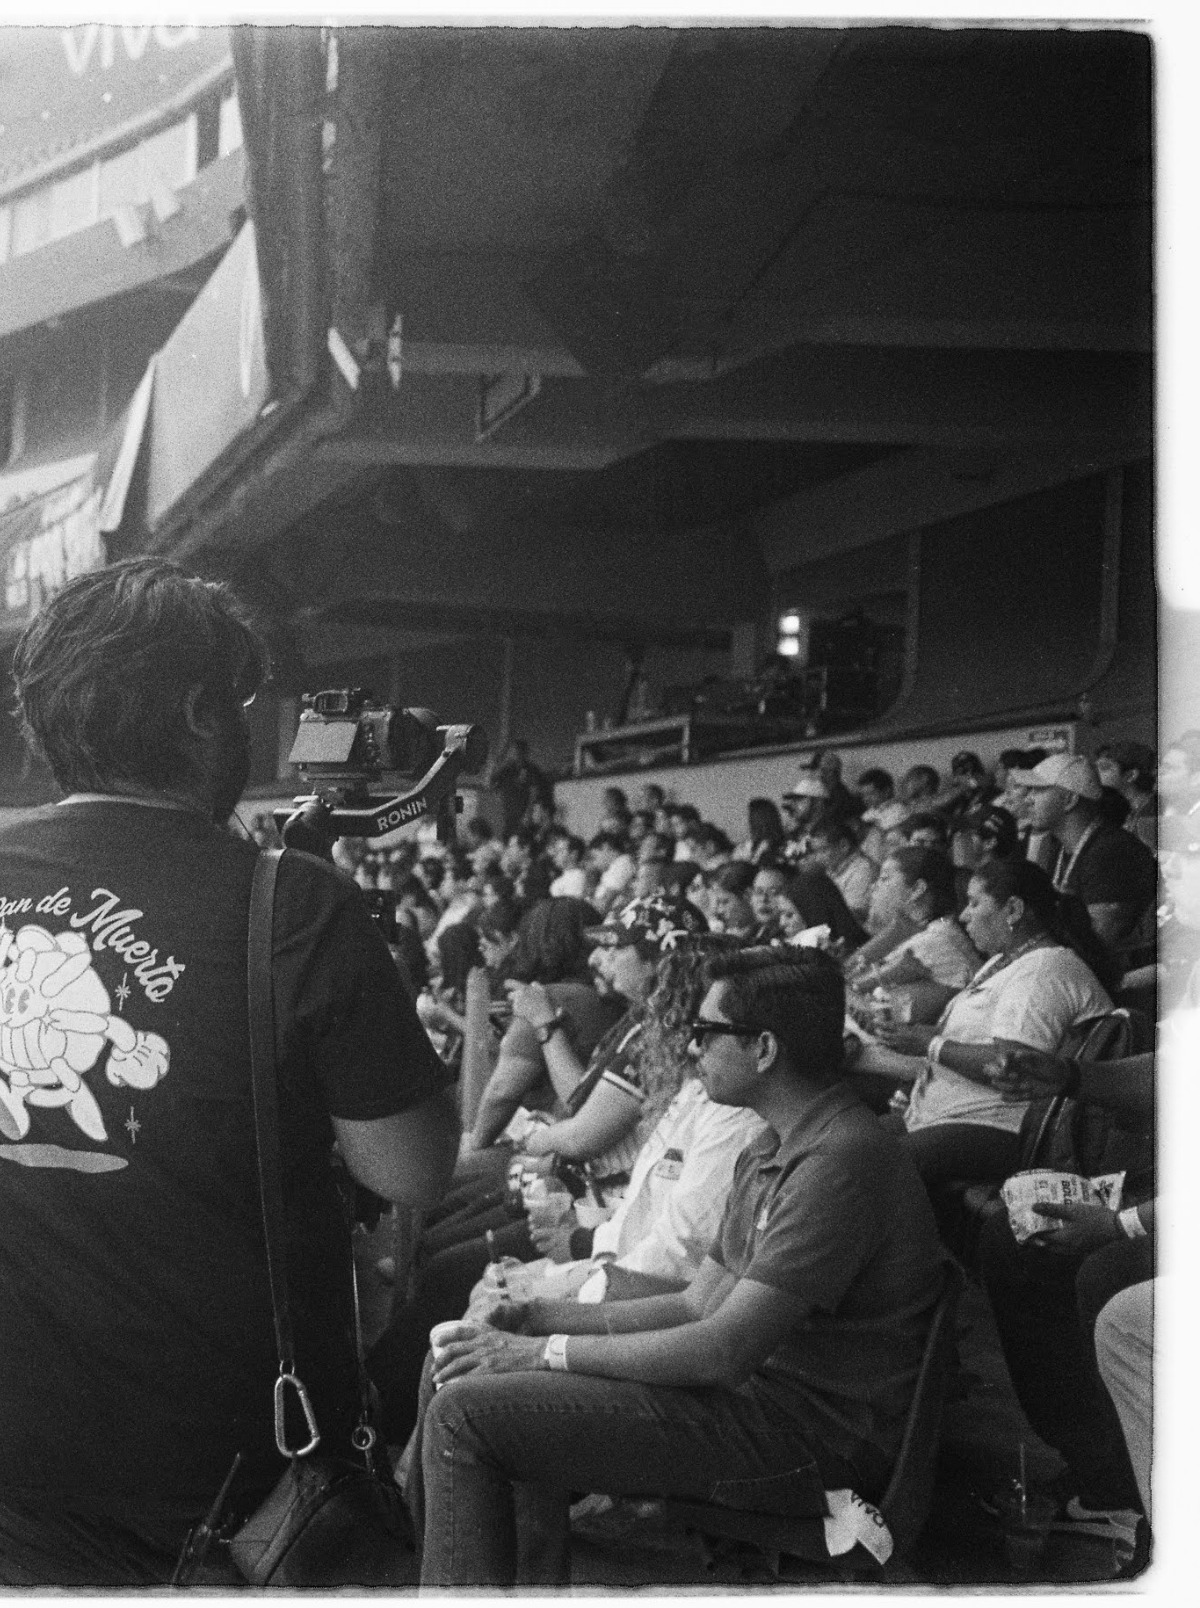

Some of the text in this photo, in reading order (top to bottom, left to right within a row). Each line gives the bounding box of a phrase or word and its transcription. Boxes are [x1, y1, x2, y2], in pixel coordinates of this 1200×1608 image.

[376, 796, 428, 831] RONIN
[35, 887, 72, 916] de
[70, 888, 186, 1003] Muerto
